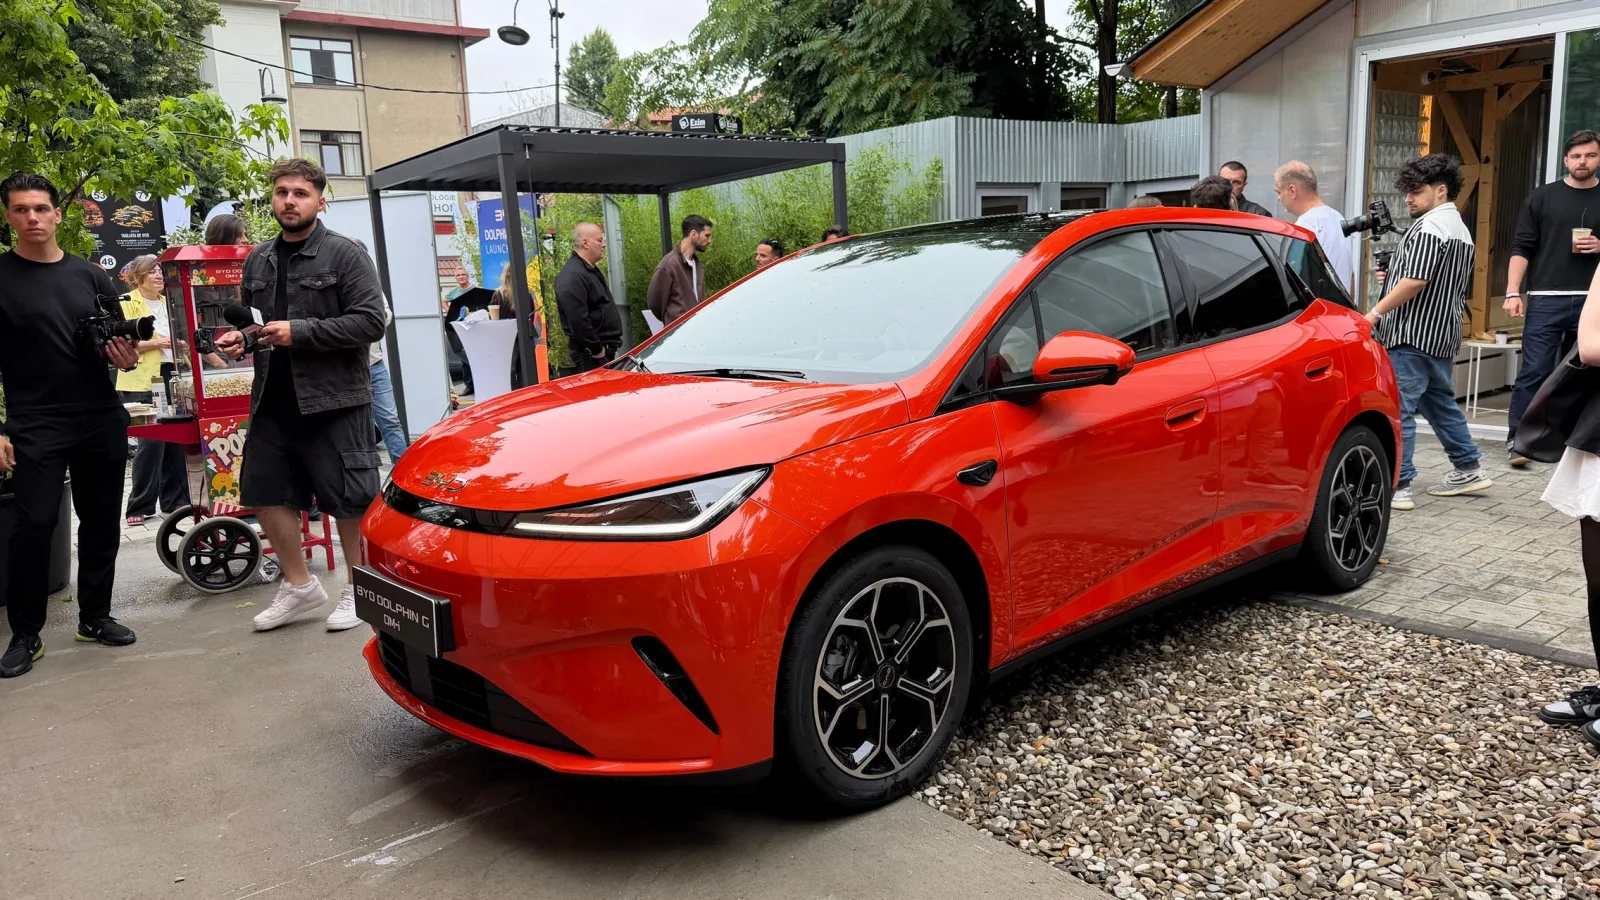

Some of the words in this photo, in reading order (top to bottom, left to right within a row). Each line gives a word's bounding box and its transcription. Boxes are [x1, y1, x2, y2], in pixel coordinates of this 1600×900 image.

[689, 118, 706, 126] Exim
[101, 258, 114, 266] 48
[421, 471, 468, 492] BYD
[356, 584, 376, 602] BYD
[376, 594, 420, 624] DOLPHIN
[421, 615, 430, 629] G
[383, 613, 401, 632] DM-i
